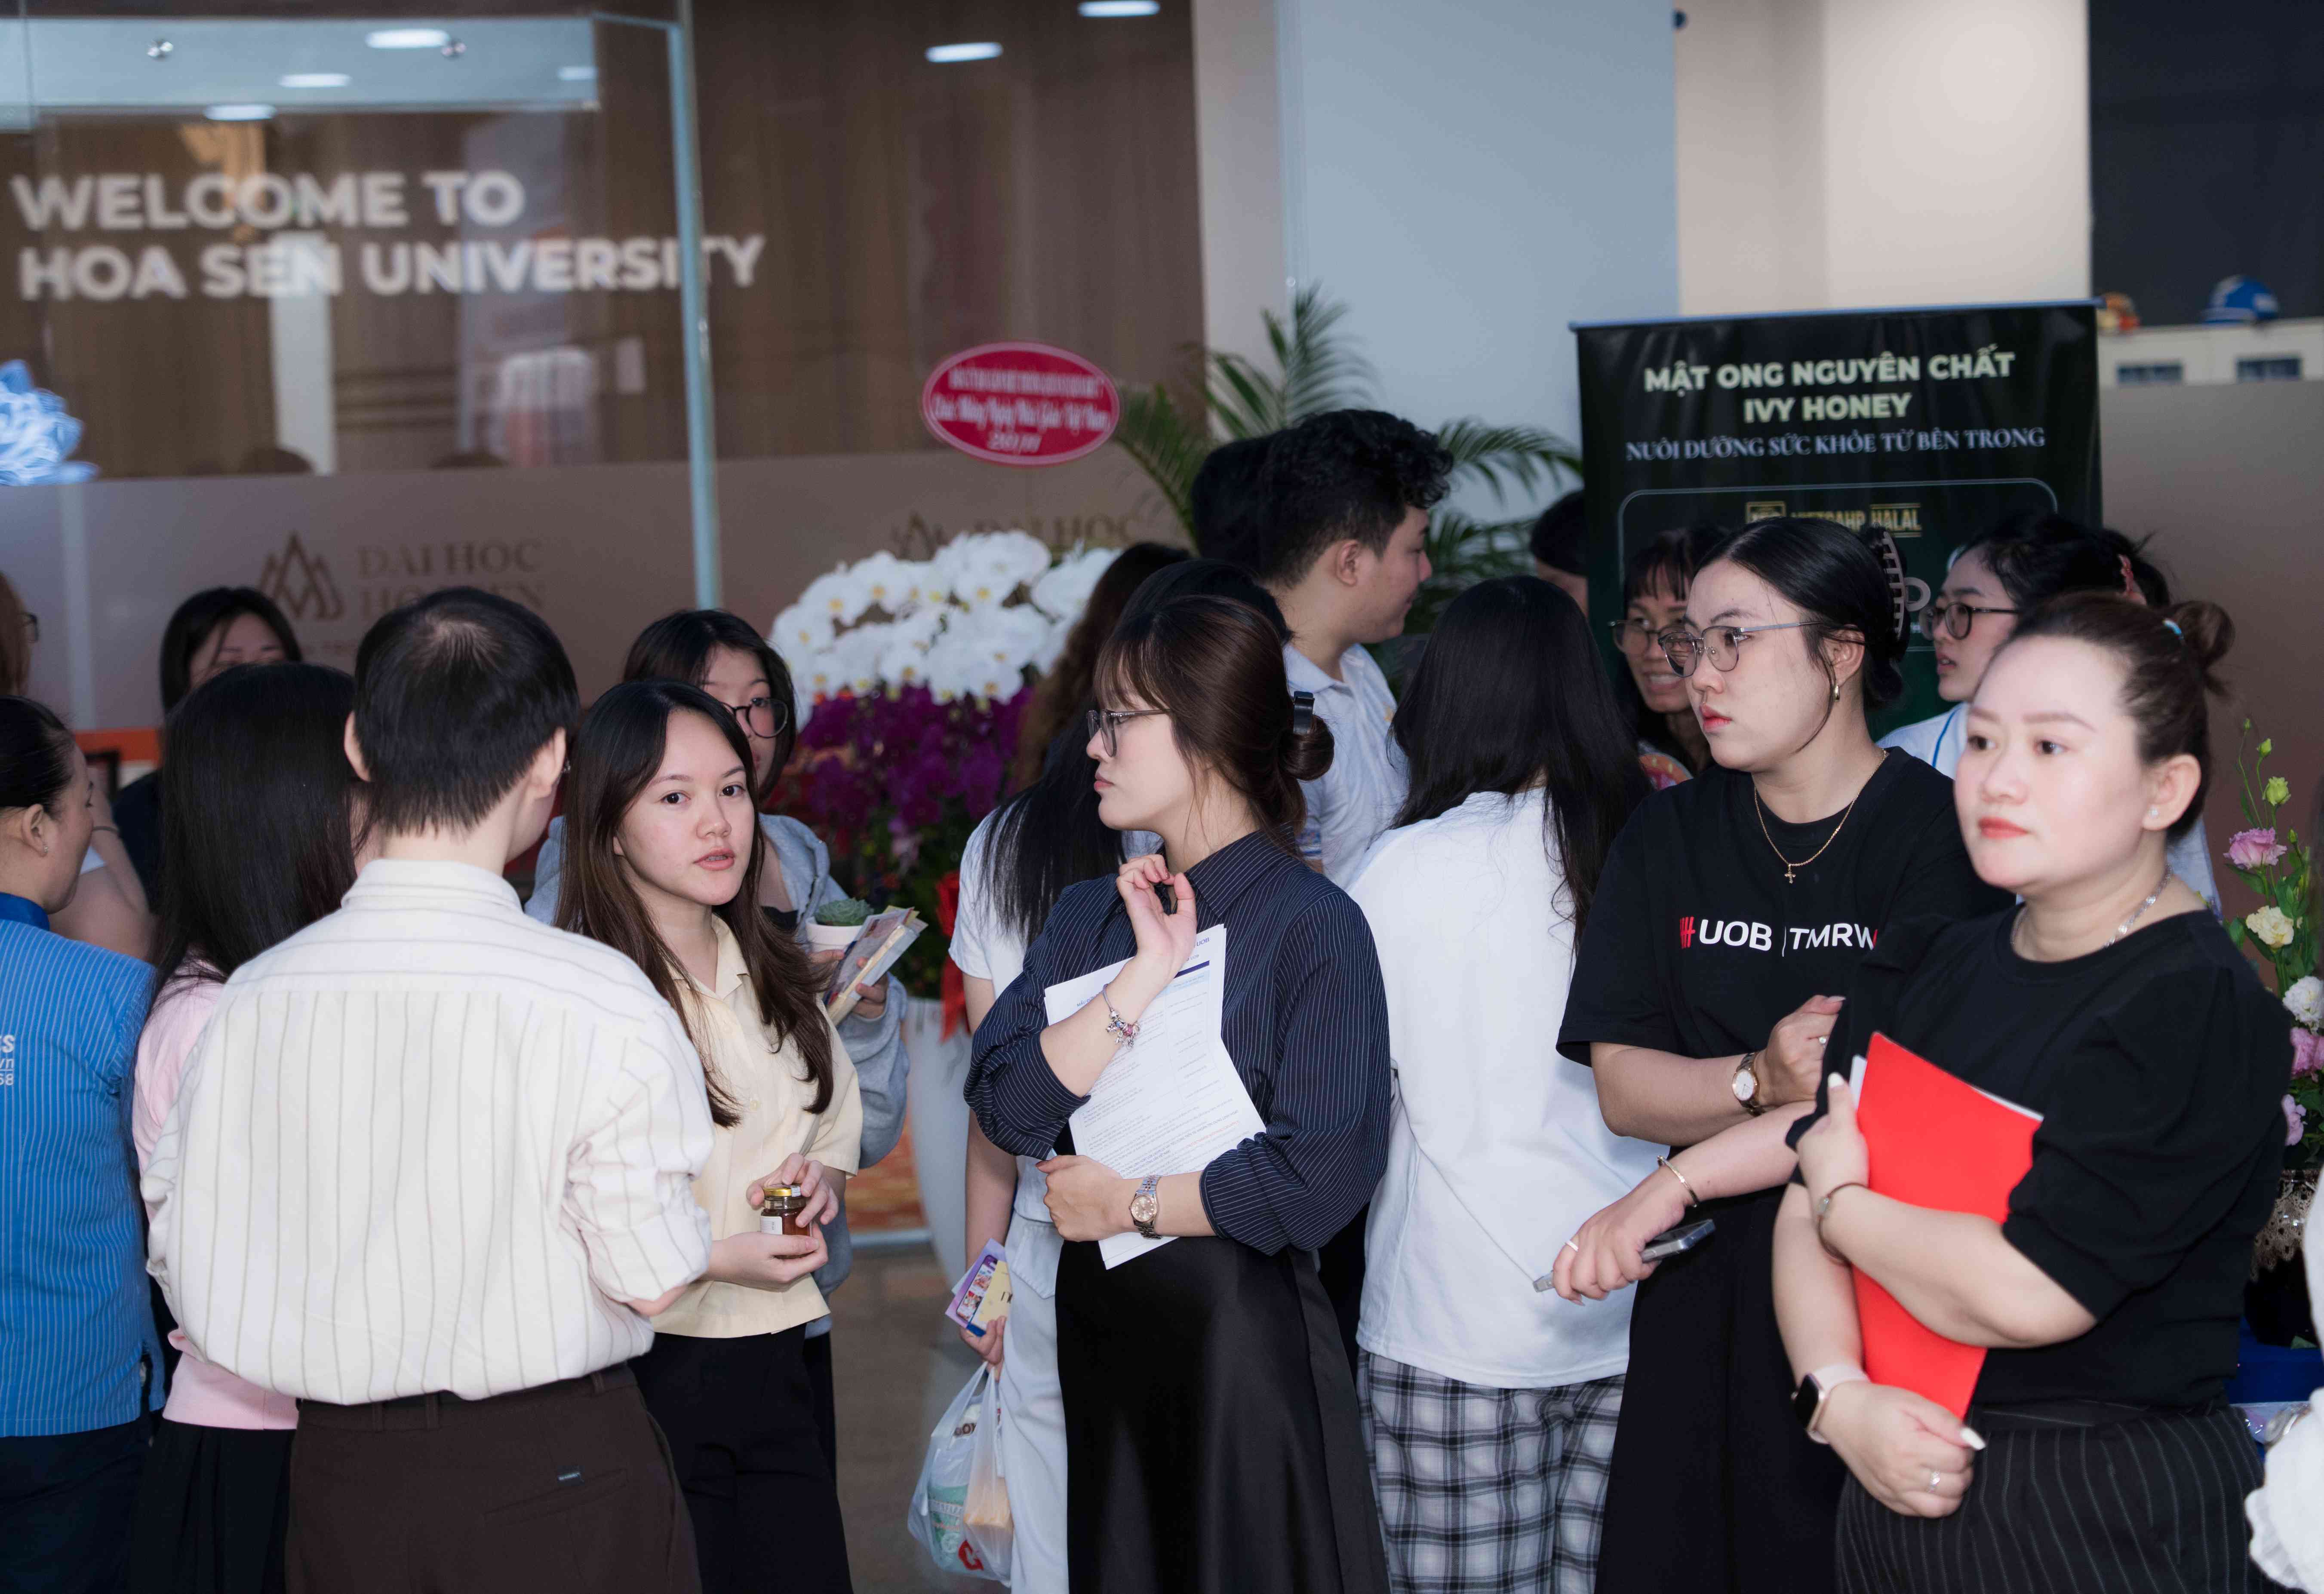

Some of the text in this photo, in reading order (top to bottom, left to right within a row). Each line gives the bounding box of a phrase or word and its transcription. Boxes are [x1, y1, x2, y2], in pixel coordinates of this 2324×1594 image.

[9, 170, 526, 230] WELCOME TO
[20, 243, 188, 301] HOA
[200, 241, 342, 299] SEN
[1644, 343, 2016, 397] MẬT ONG NGUYÊN CHẤT
[1743, 392, 1912, 424] IVY HONEY
[1626, 426, 2046, 461] NUÔI DƯỠNG SỨC KHỎE TỪ BÊN TRONG
[1196, 937, 1210, 946] UOB
[1699, 919, 1878, 952] UOB TMRW
[0, 1035, 14, 1053] S
